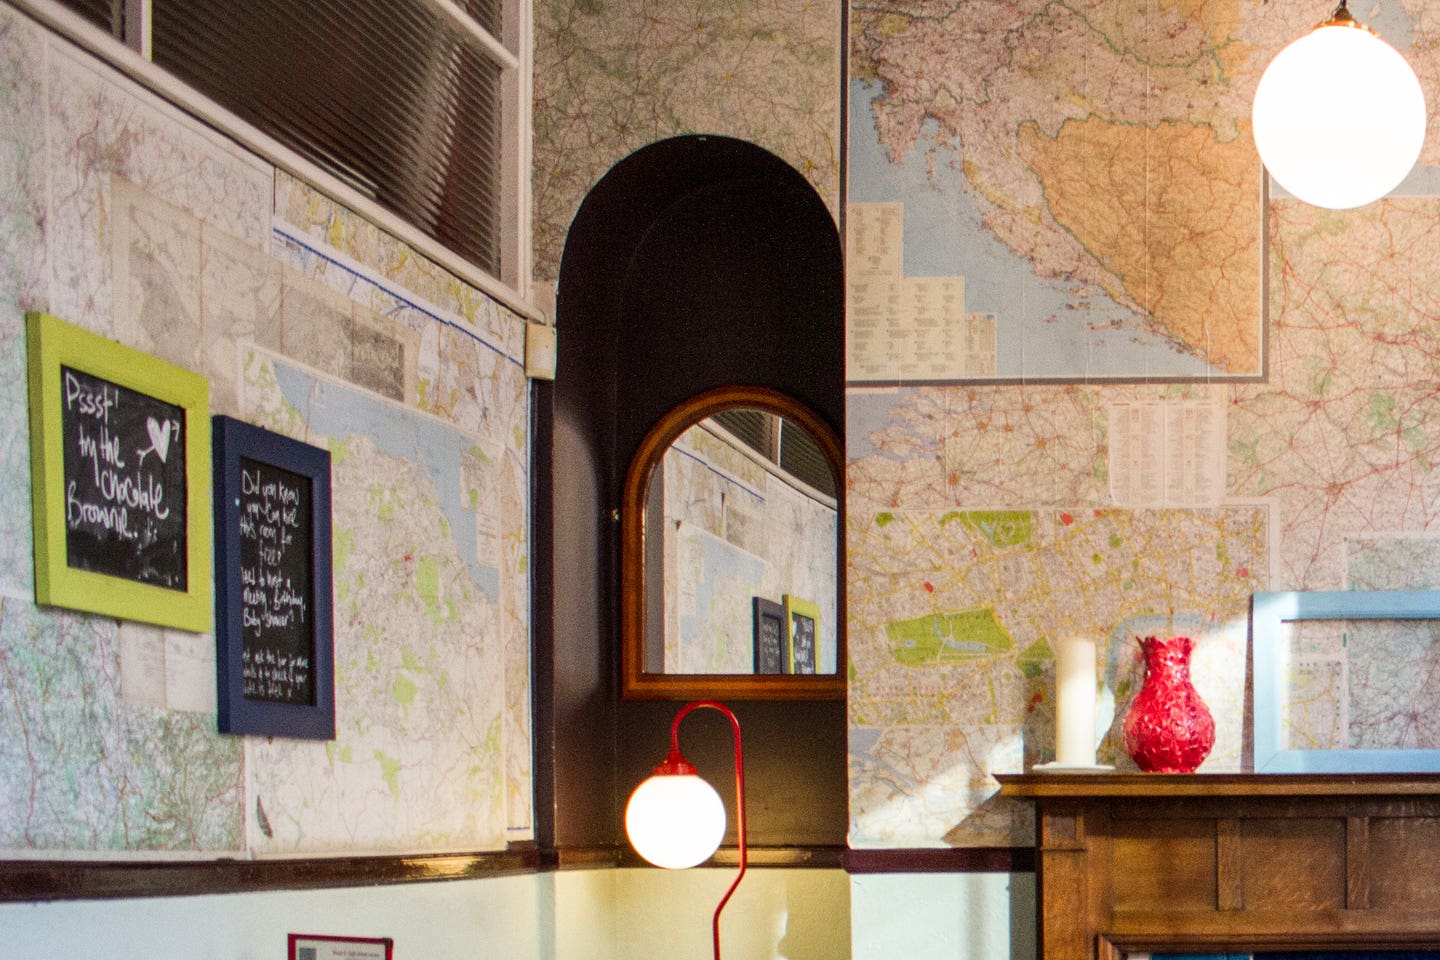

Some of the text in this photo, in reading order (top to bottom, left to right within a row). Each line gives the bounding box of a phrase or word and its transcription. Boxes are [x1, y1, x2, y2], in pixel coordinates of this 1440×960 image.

[79, 425, 125, 487] try the
[242, 469, 260, 495] Did
